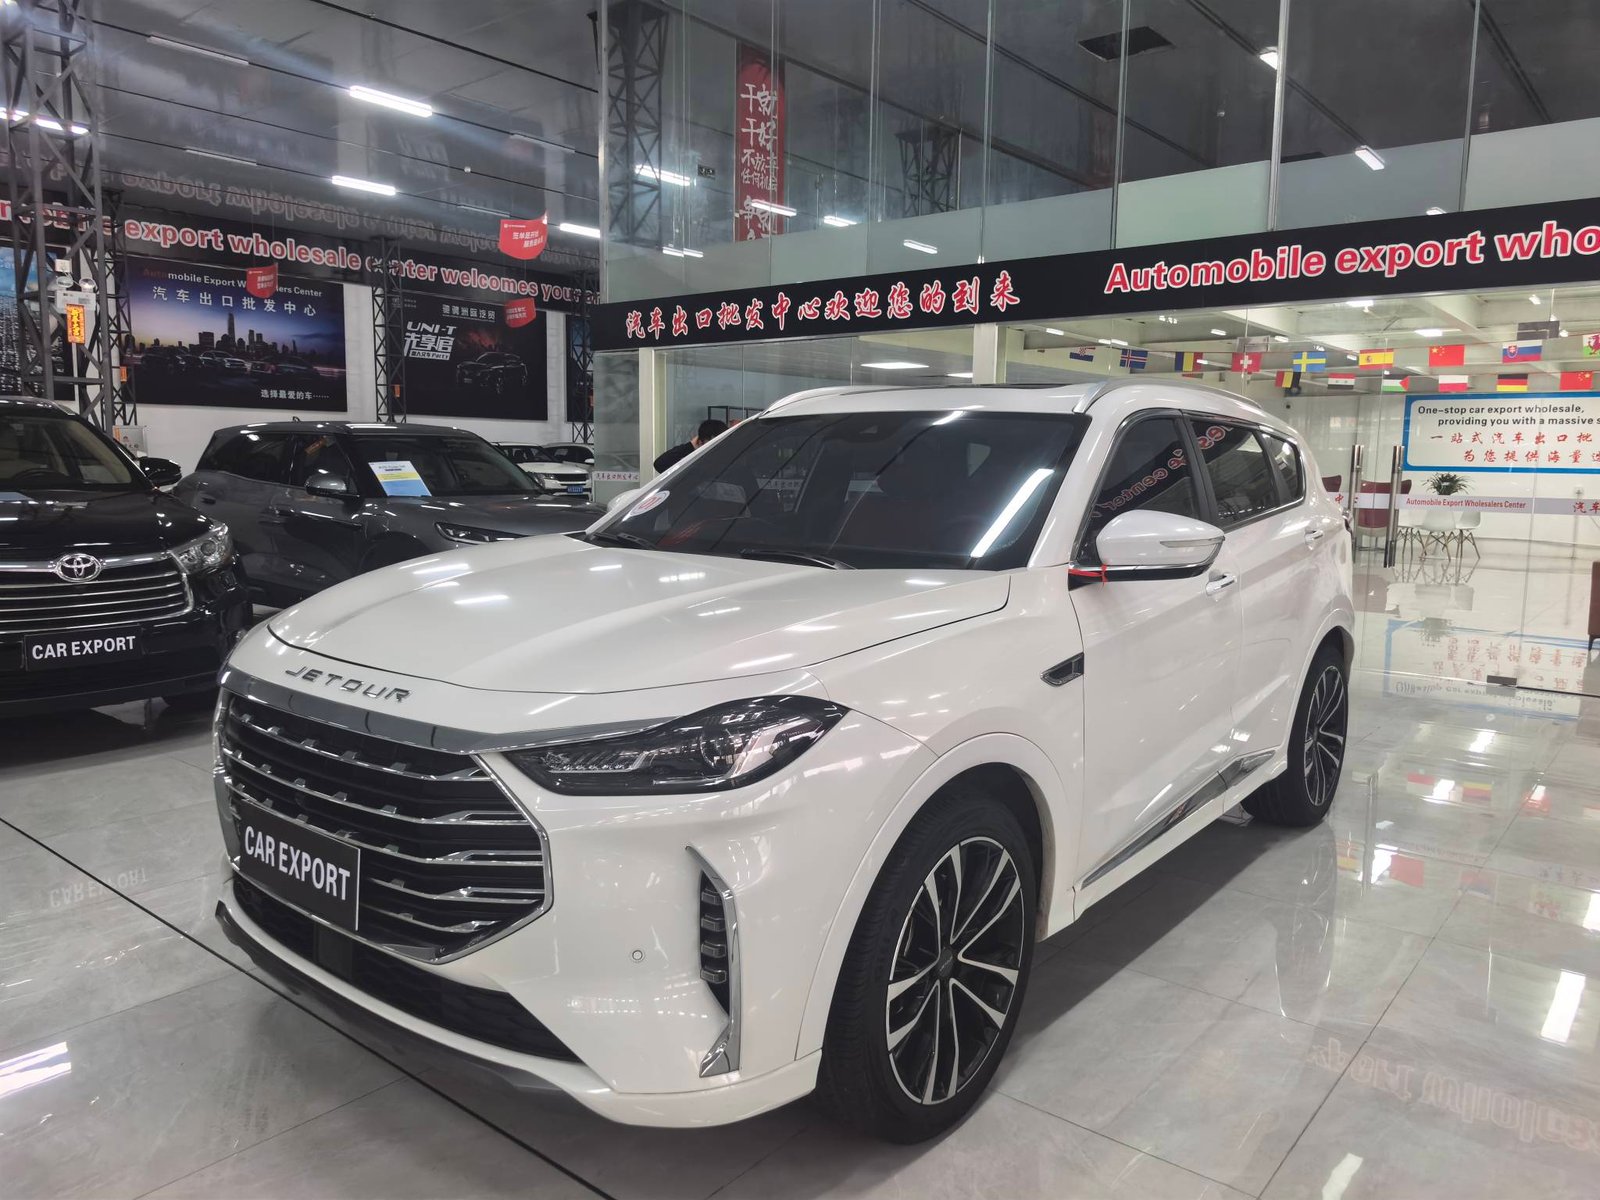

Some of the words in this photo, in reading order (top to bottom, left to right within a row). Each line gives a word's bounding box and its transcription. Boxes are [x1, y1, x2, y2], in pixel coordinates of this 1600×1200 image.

[125, 219, 224, 251] export
[228, 233, 362, 271] wholesale
[441, 266, 538, 297] welcomes
[1103, 245, 1327, 294] Automobile
[1335, 229, 1484, 278] export
[1493, 220, 1600, 261] who
[204, 277, 236, 287] Export
[294, 286, 322, 297] Center
[152, 285, 317, 317] 汽车出口批发中心
[625, 270, 1021, 340] 汽车出口批发中心欢迎您的到来
[406, 321, 457, 335] UNI-T
[1418, 406, 1467, 415] One-stop
[1469, 406, 1484, 414] car
[1488, 406, 1522, 416] export
[1525, 404, 1585, 414] wholesale,
[1438, 417, 1487, 426] providing
[1490, 418, 1509, 427] you
[1513, 417, 1536, 425] with
[1547, 416, 1593, 425] massive
[1430, 432, 1593, 445] 一站式汽车出口批
[1406, 498, 1442, 506] Automobile
[1442, 499, 1464, 507] Export
[1464, 500, 1503, 509] Wholesalers
[1504, 501, 1526, 509] Center
[32, 643, 68, 660] CAR
[71, 635, 136, 656] EXPORT
[285, 666, 412, 702] JETOUR
[244, 825, 276, 867] CAR
[278, 841, 351, 900] EXPORT
